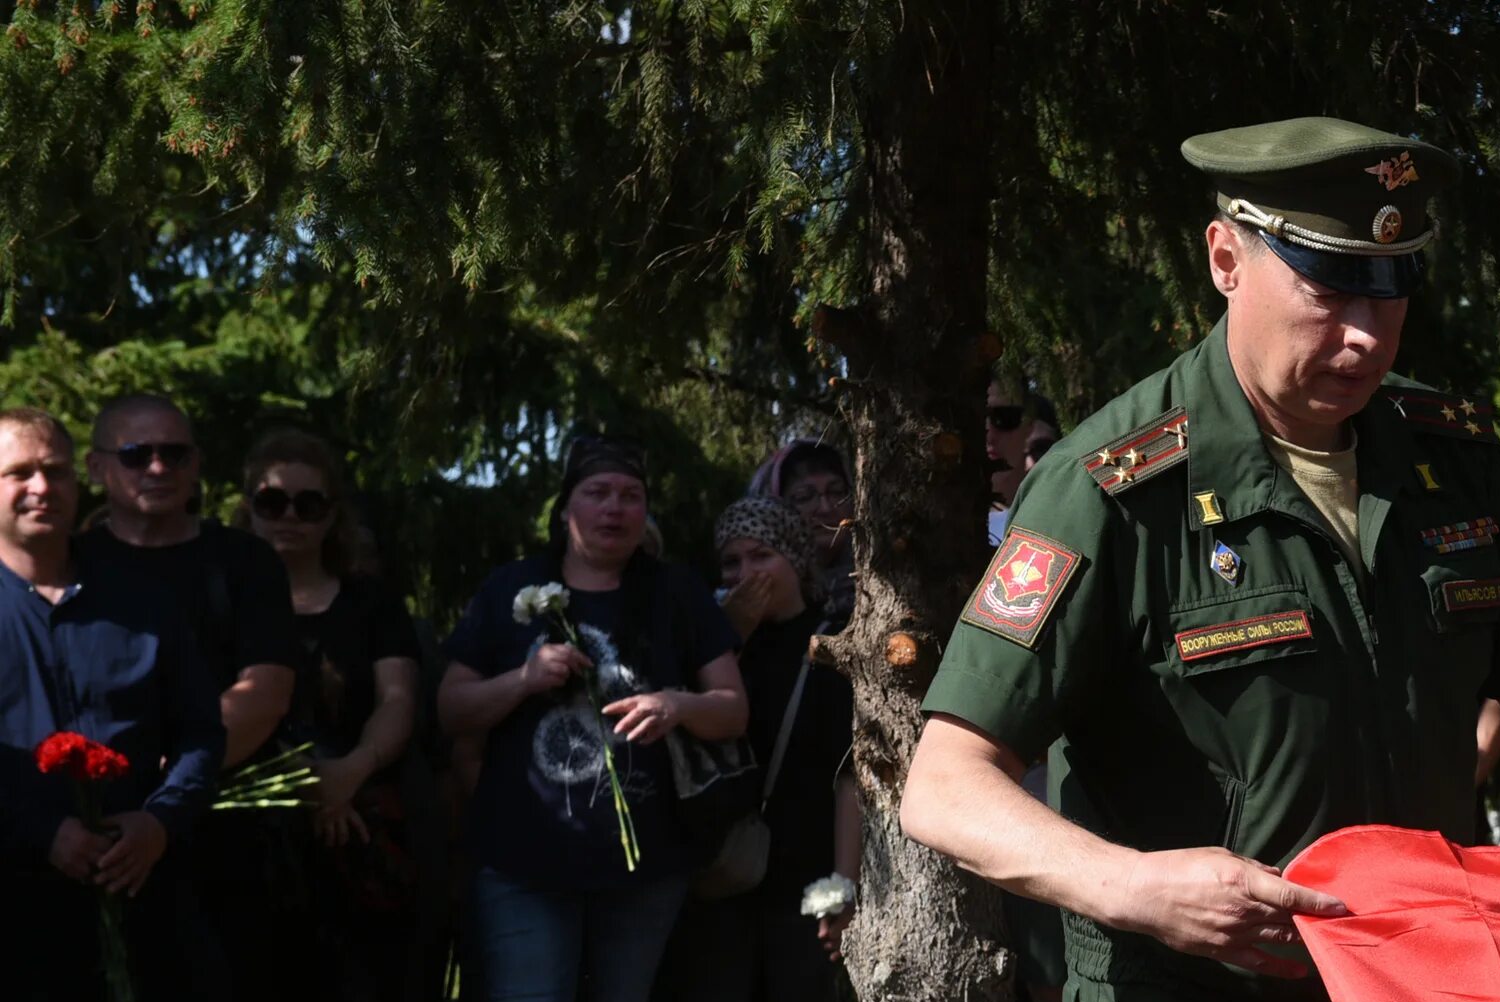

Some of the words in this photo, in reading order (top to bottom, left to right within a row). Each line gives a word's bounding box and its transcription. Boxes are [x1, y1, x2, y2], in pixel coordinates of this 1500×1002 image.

[1454, 586, 1496, 602] ИЛЬЯСОВ
[1181, 629, 1246, 653] ВООРУЖЕННЫЕ
[1247, 624, 1272, 639] СИЛЫ
[1273, 619, 1306, 633] РОССИИ
